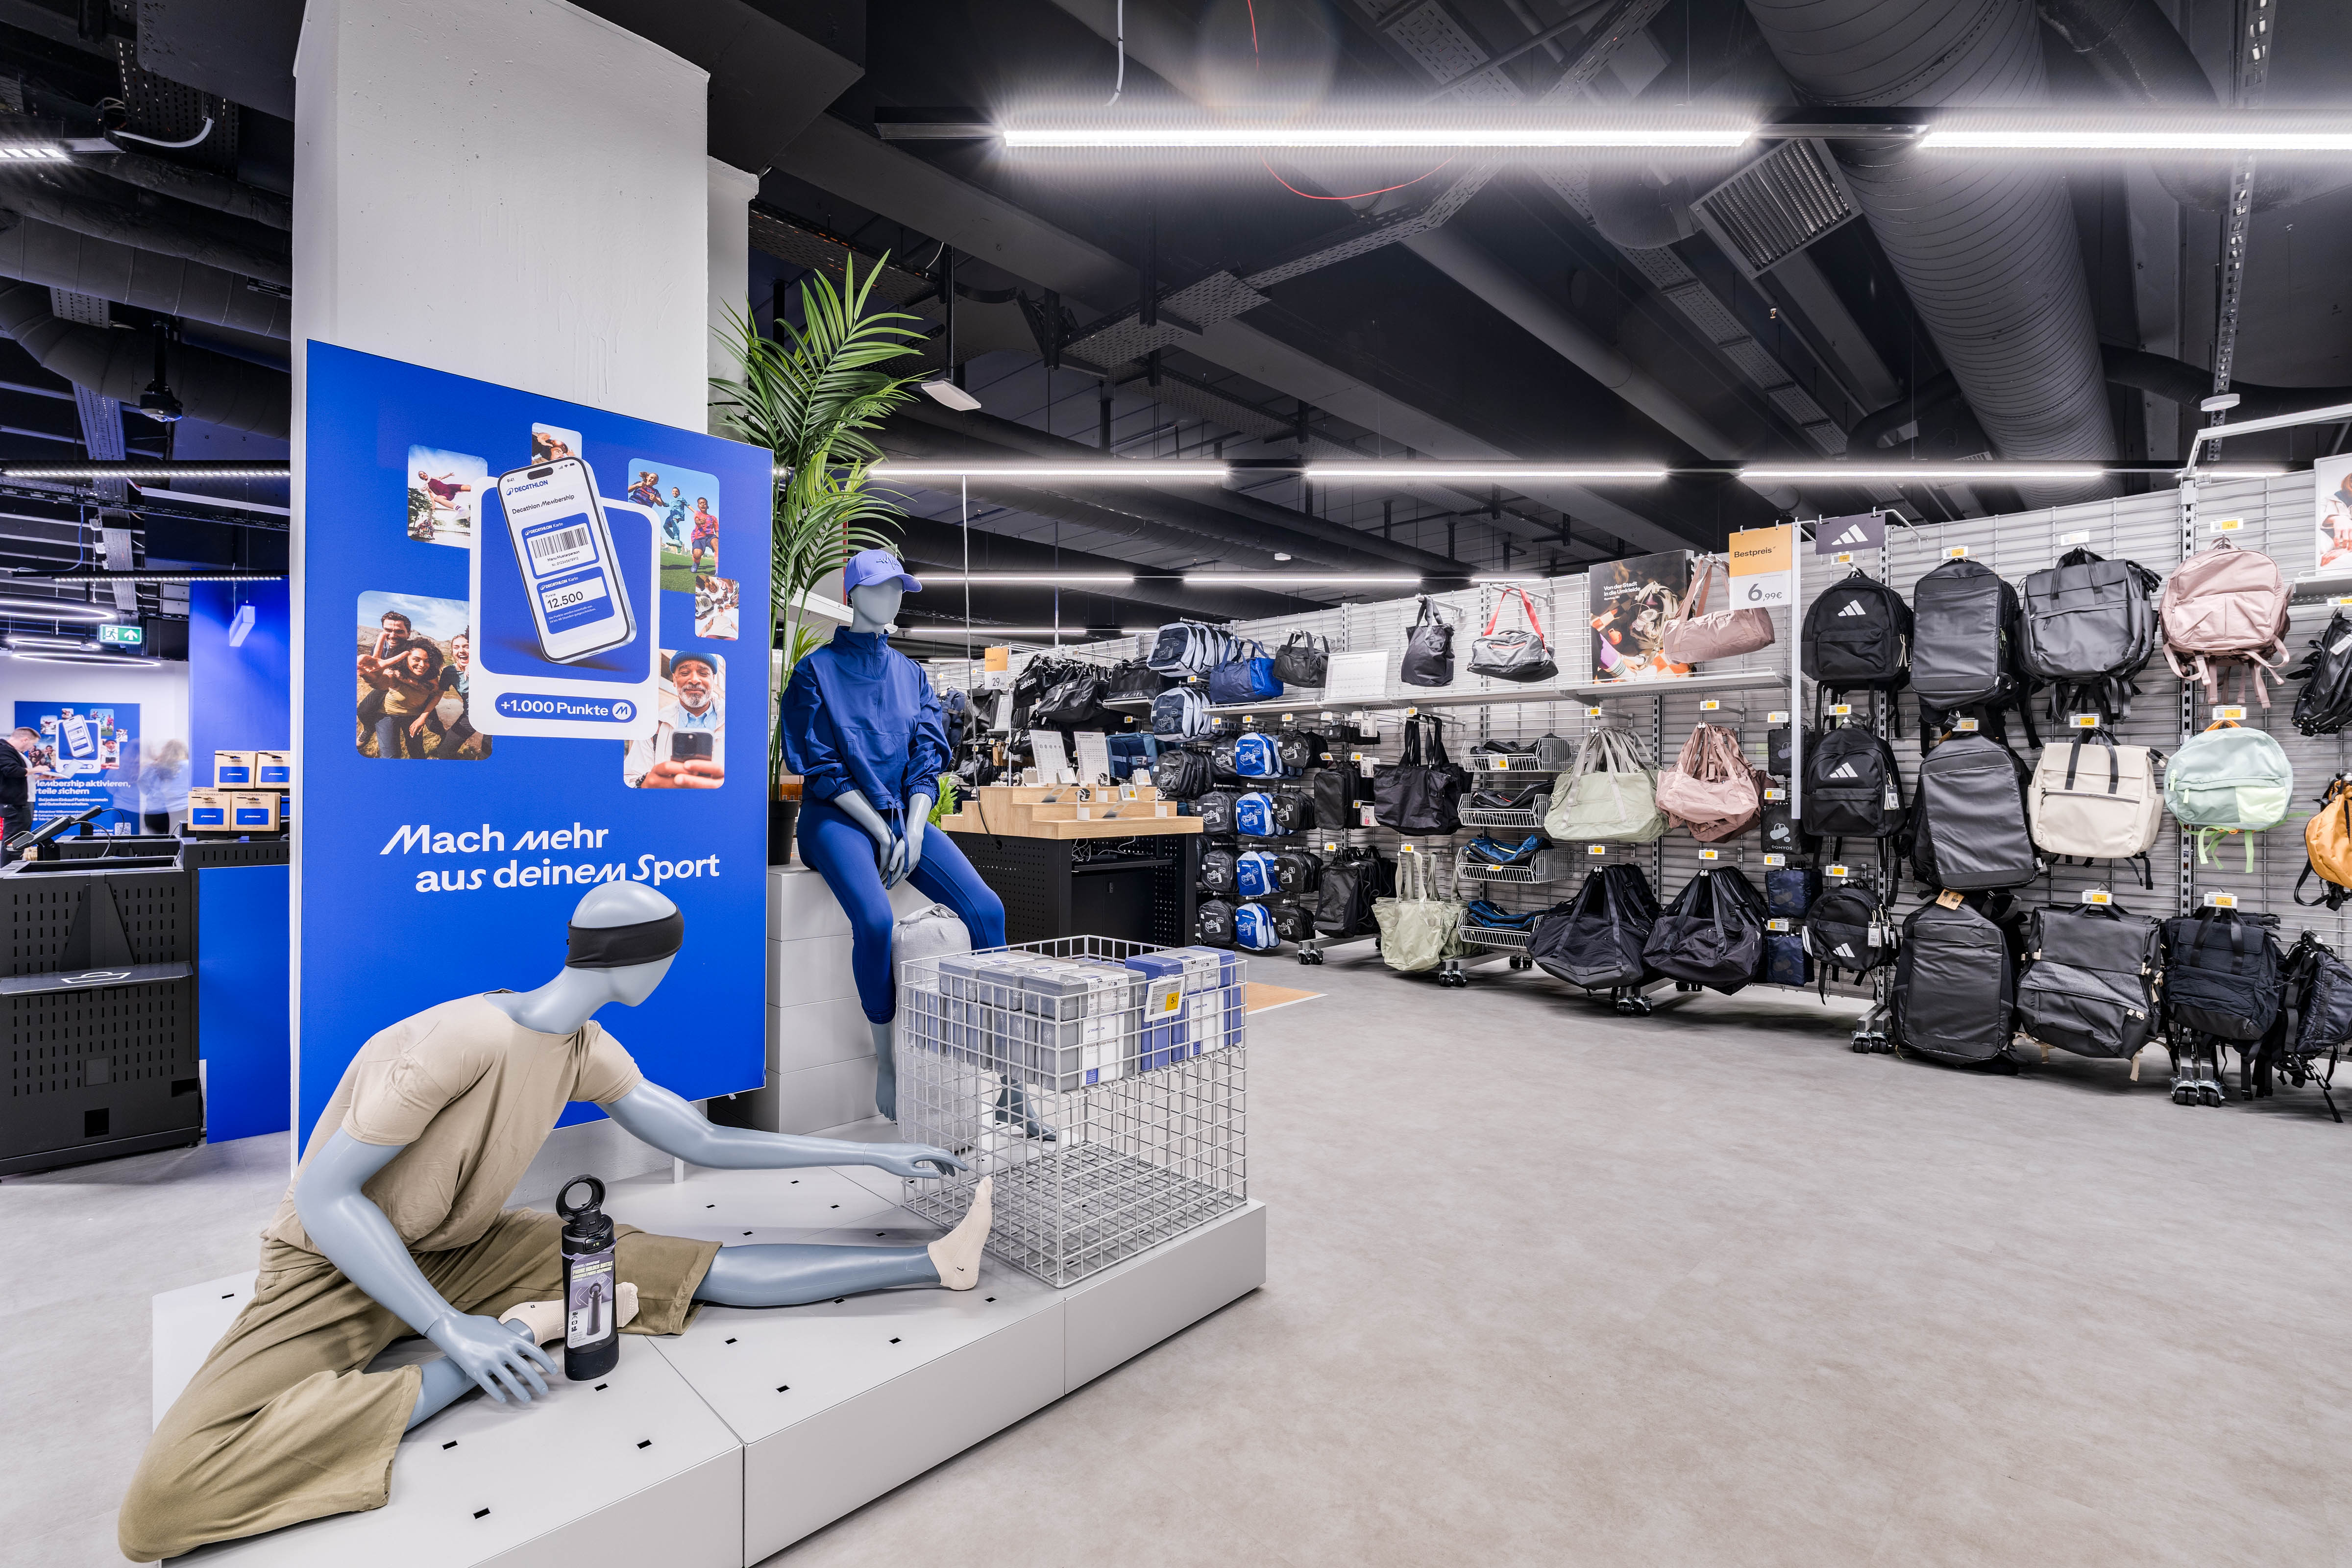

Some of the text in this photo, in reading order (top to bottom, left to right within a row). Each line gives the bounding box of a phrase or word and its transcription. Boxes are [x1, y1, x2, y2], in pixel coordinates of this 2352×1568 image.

[514, 480, 549, 493] DECATHLON
[512, 494, 575, 514] Decathlon Membership
[530, 525, 553, 534] DECATHLON
[557, 550, 580, 560] Musterperson
[1734, 547, 1772, 558] Bestpreis
[545, 579, 567, 588] DECATHLON
[1748, 583, 1783, 602] 6,99€
[547, 591, 584, 609] 12.500
[1020, 678, 1037, 690] adidas
[501, 700, 554, 713] +1.000
[557, 702, 609, 716] Punkte
[85, 780, 131, 788] aktivieren,
[379, 822, 609, 855] Mach mehr
[416, 854, 720, 892] aus deinem Sport
[586, 1264, 600, 1272] HOLDER
